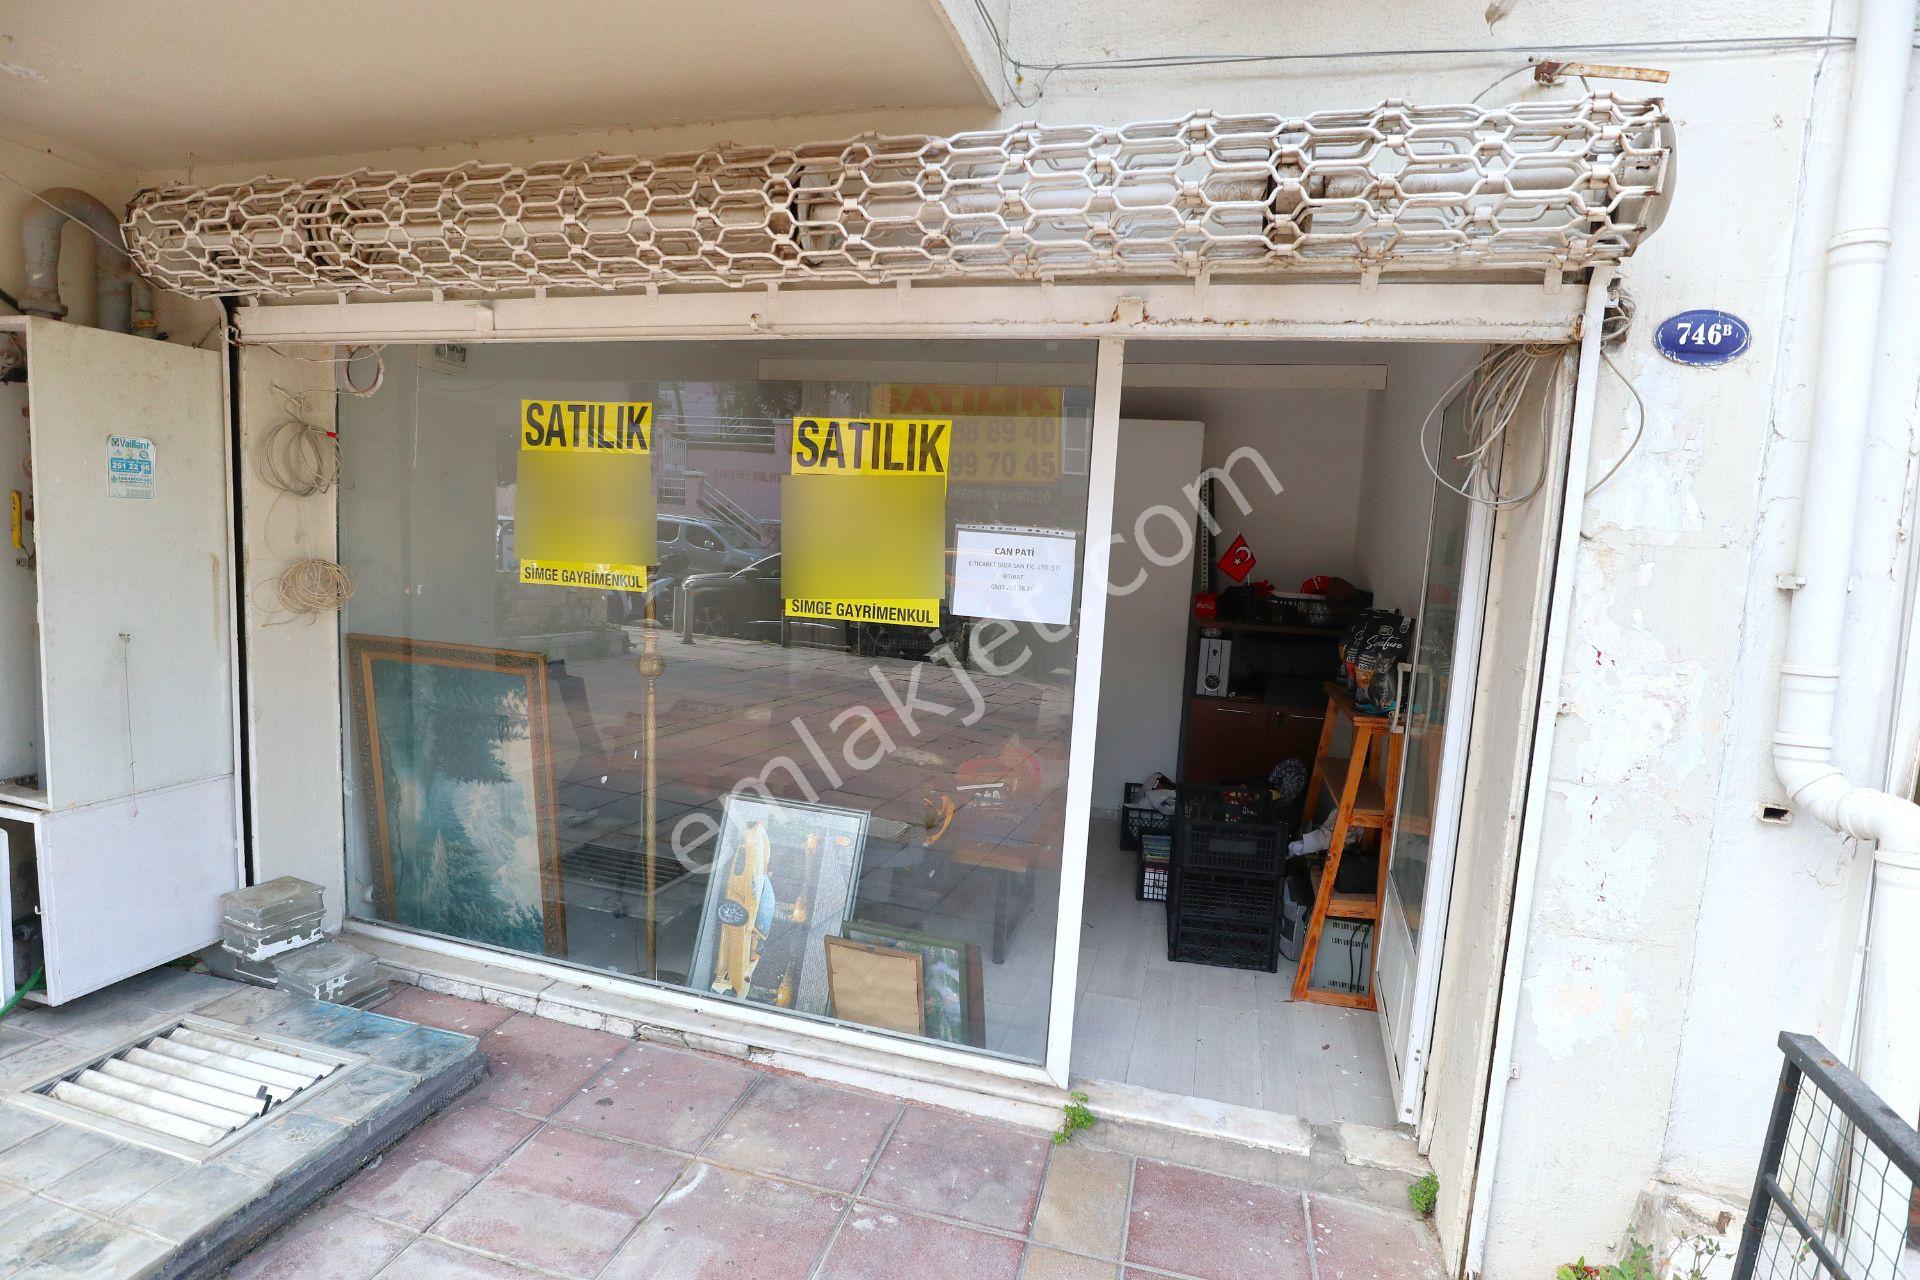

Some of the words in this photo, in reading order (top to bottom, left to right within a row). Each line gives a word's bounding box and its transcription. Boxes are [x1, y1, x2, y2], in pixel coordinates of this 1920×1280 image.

[525, 402, 649, 450] SATILIK
[120, 438, 150, 450] Vaillant
[796, 419, 946, 473] SATILIK
[986, 451, 1016, 477] 70
[1024, 451, 1056, 477] 45
[994, 547, 1013, 556] CAN
[1015, 547, 1035, 557] PATİ
[561, 570, 643, 589] GAYRİMENKUL
[836, 603, 934, 624] GAYRİMENKUL
